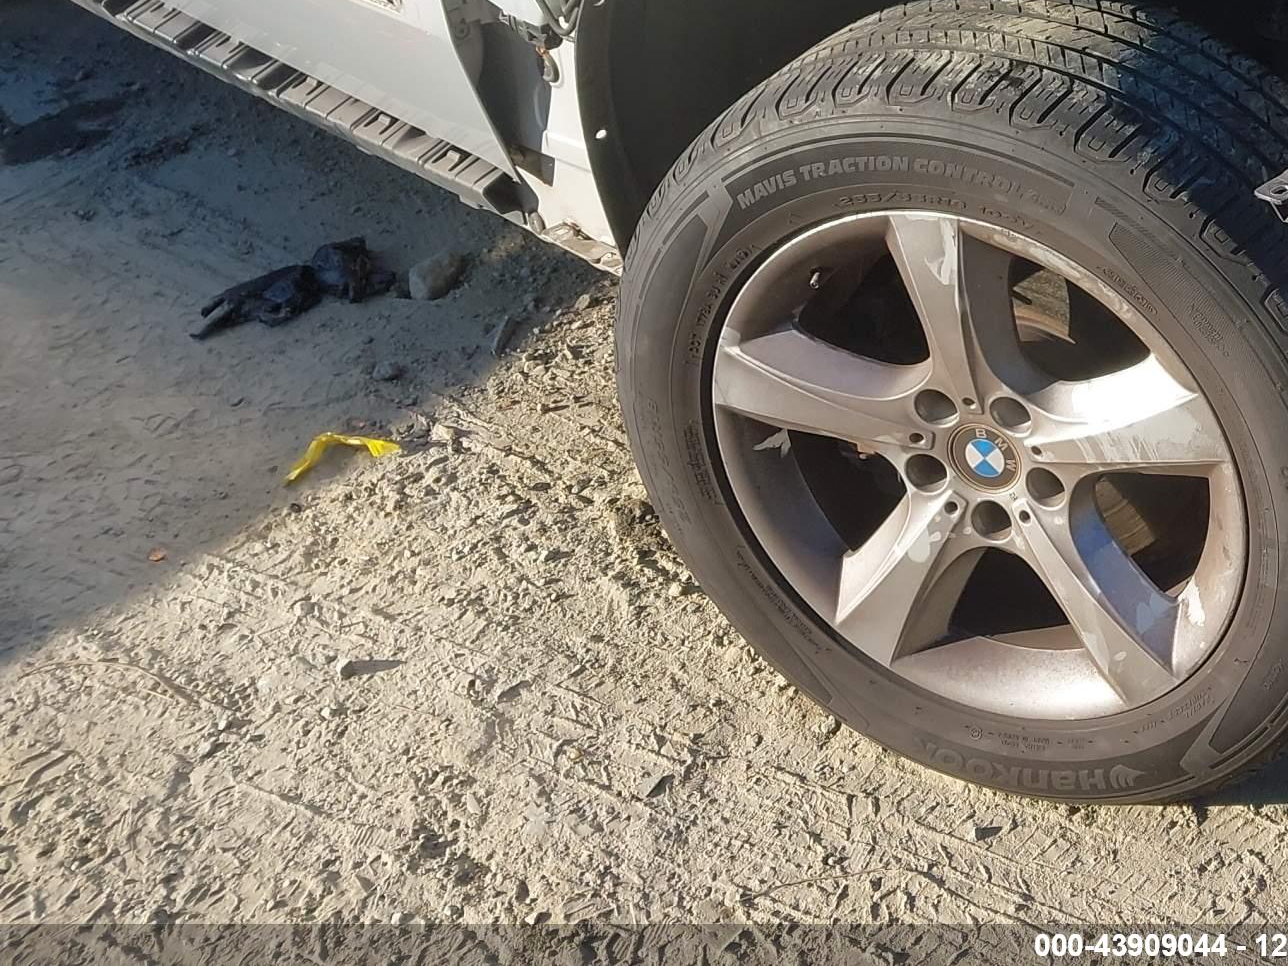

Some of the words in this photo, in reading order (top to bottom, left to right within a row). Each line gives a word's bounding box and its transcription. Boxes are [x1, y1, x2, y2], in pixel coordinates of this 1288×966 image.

[737, 170, 797, 211] MAVIS
[799, 155, 910, 182] TRACTION
[975, 428, 1017, 472] BMW
